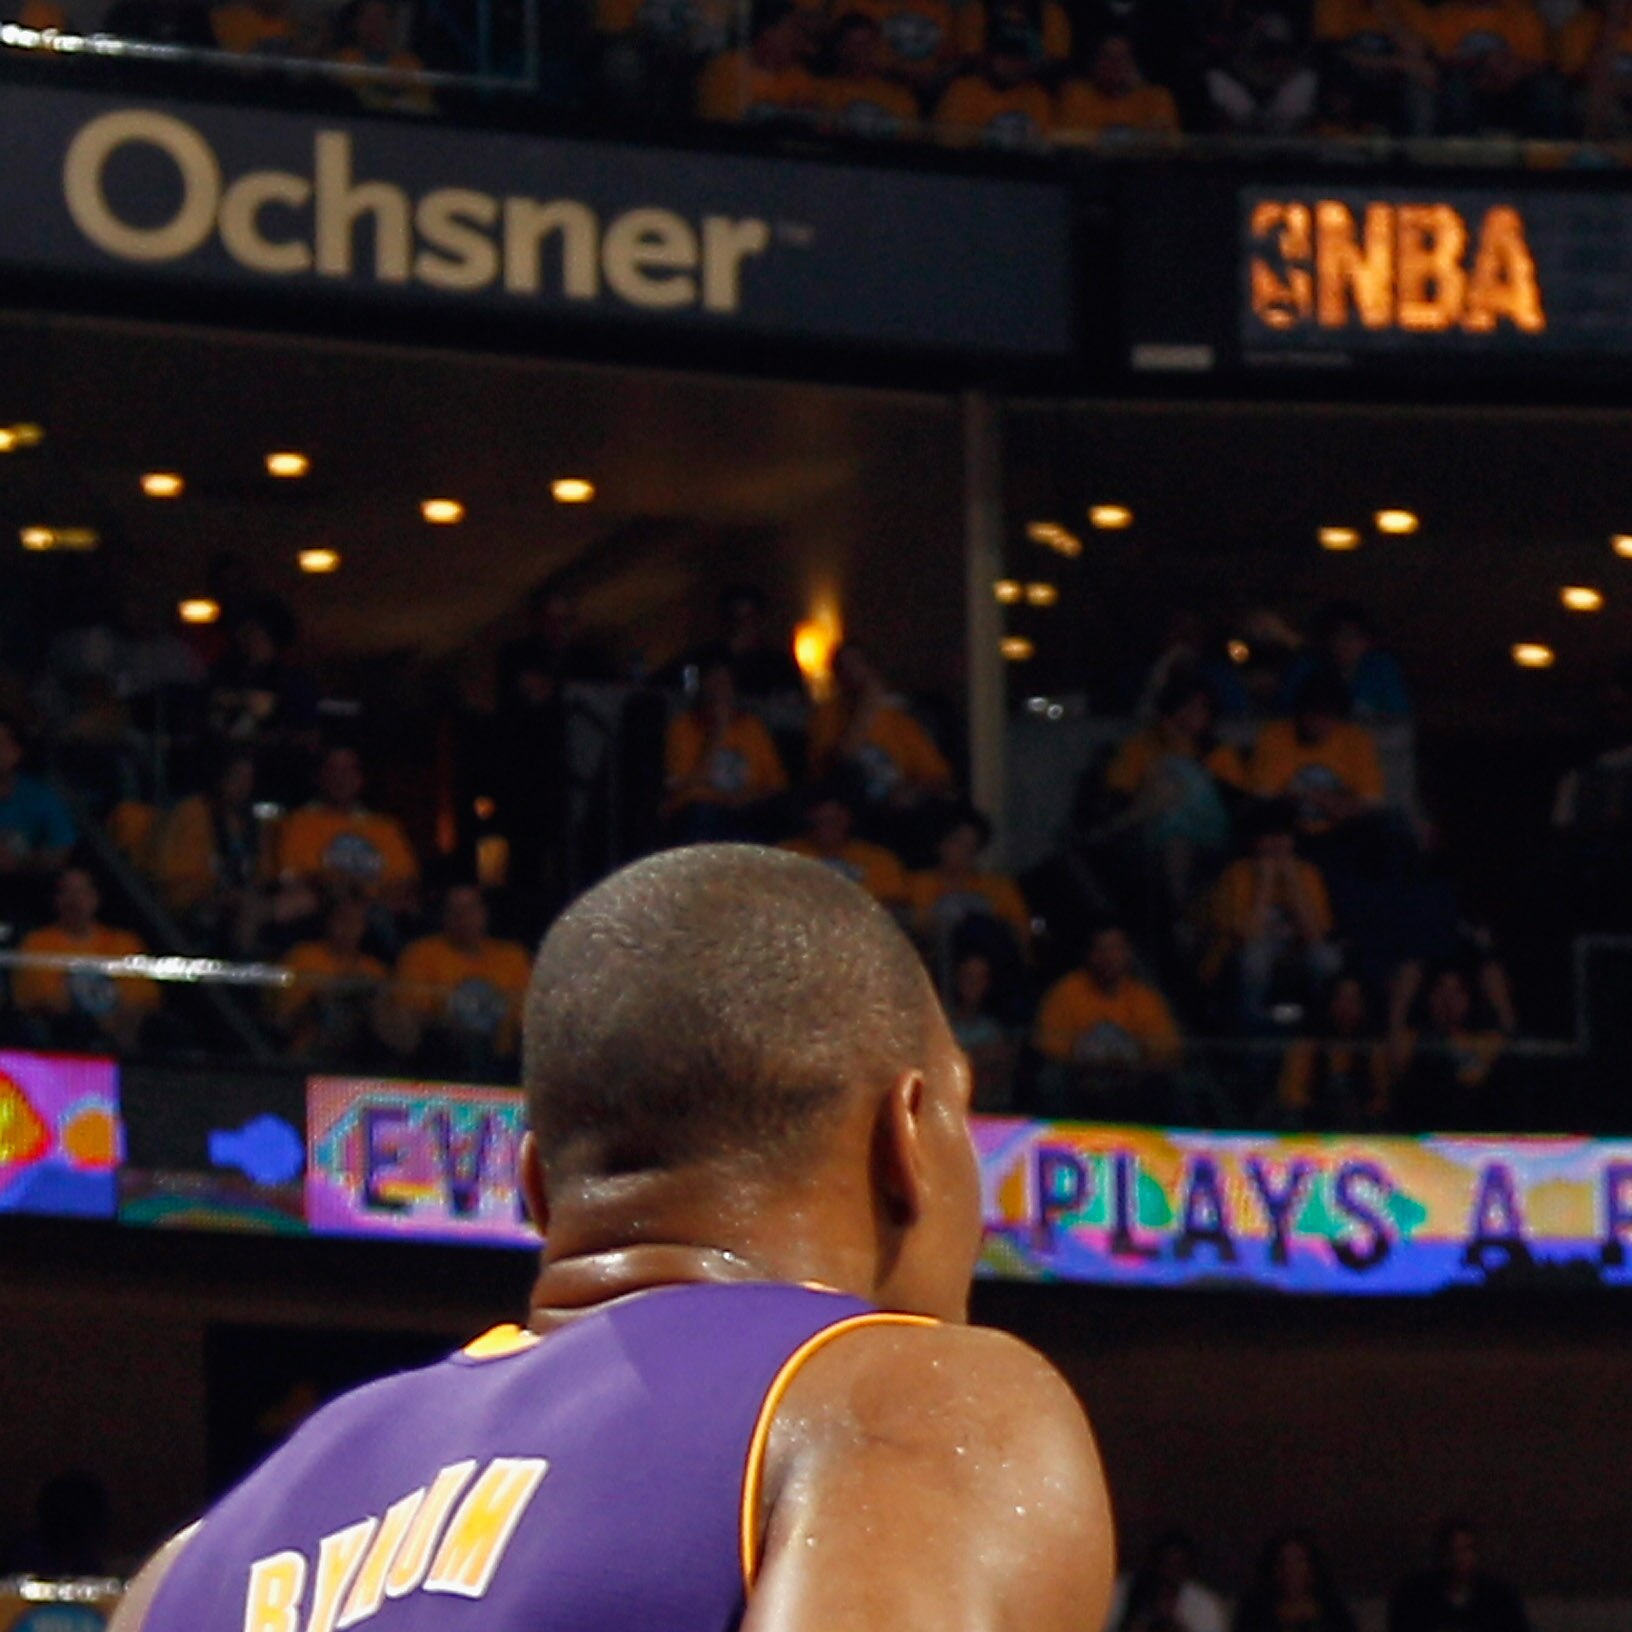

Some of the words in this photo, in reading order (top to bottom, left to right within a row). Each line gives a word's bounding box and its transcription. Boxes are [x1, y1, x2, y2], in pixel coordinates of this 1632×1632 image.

[62, 109, 769, 312] Ochsner
[1315, 199, 1546, 333] NBA
[363, 1107, 530, 1223] EV
[1029, 1142, 1395, 1272] PLAYS
[1465, 1160, 1532, 1271] A
